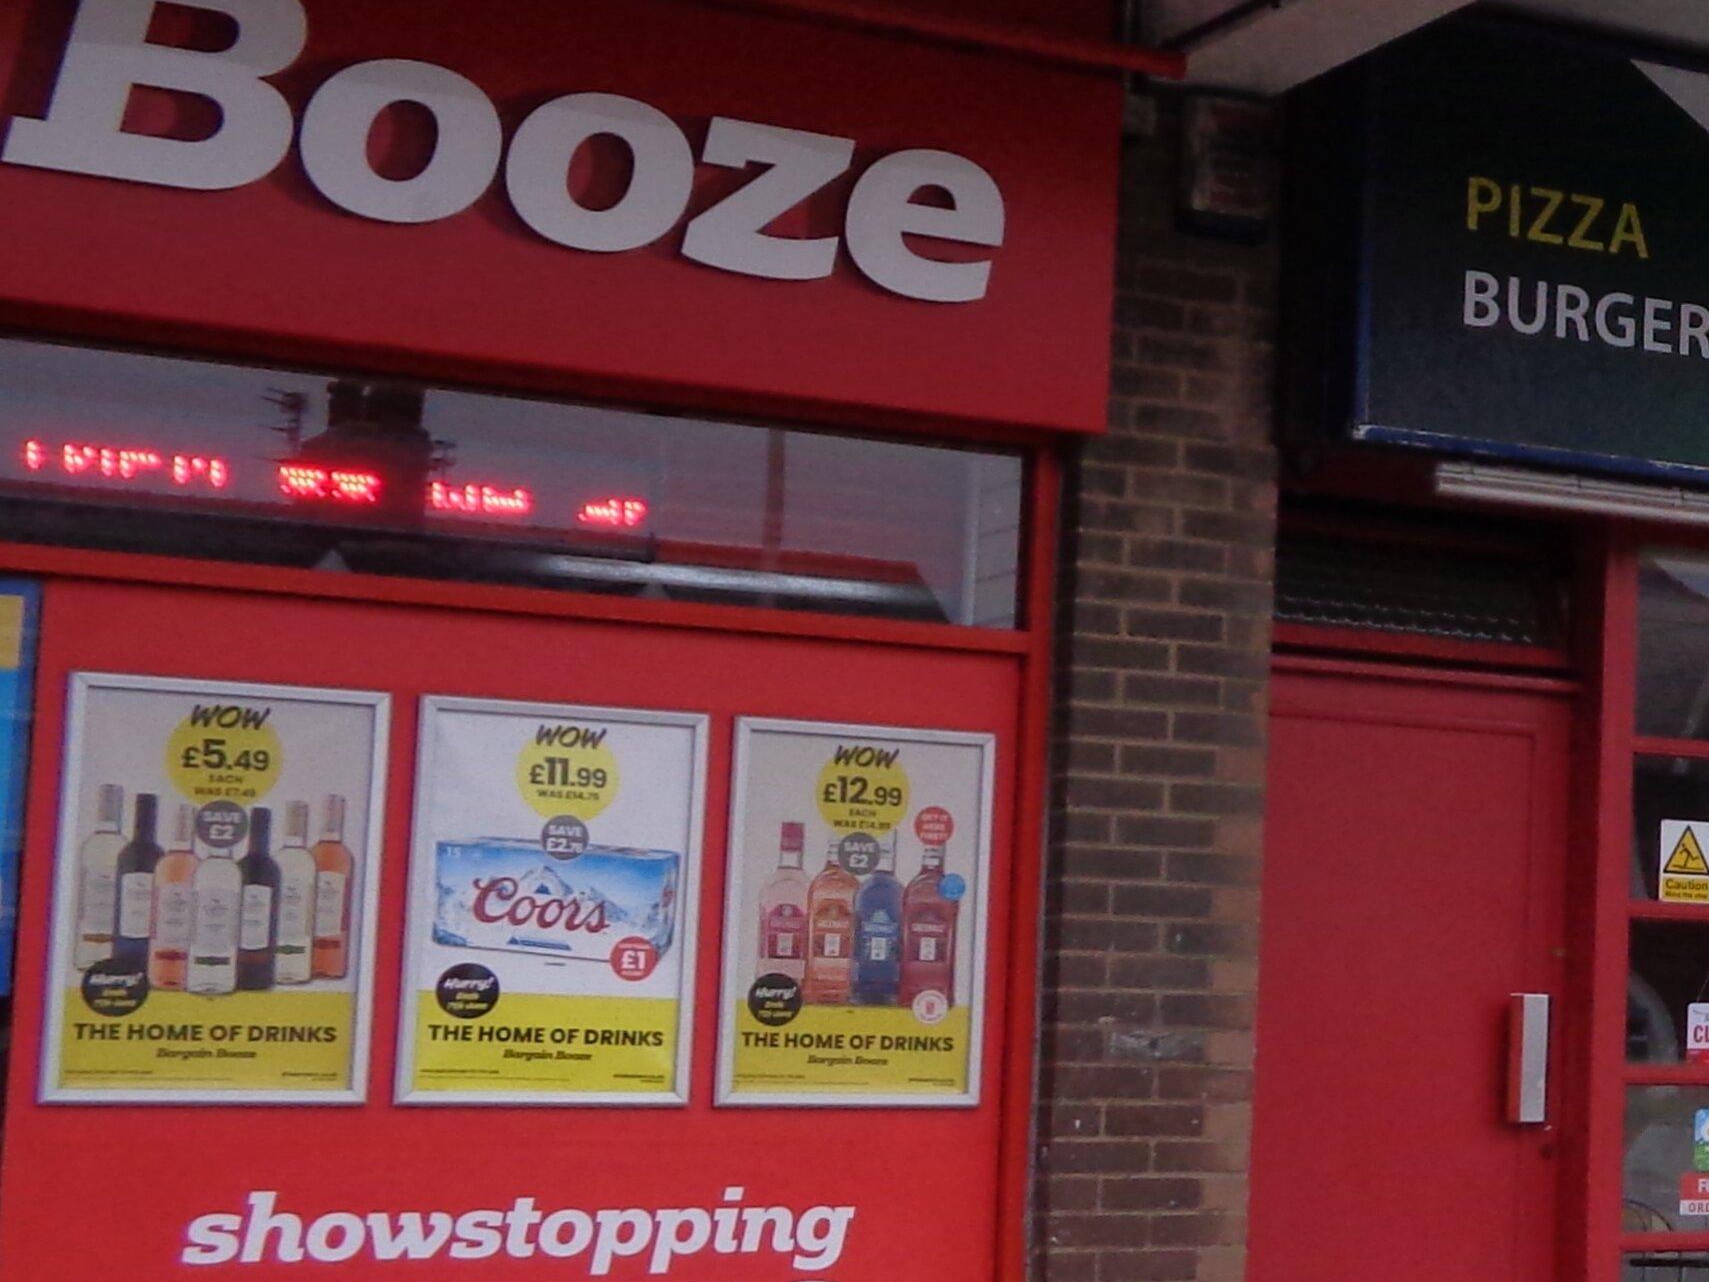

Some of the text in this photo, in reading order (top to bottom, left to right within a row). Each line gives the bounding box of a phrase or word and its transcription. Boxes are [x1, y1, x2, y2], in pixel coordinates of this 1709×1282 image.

[1467, 176, 1650, 259] PIZZA
[190, 704, 271, 730] WOW
[535, 724, 607, 749] WOW
[182, 738, 270, 771] £5.49
[834, 745, 899, 769] WOW
[530, 757, 606, 788] £11.99
[823, 776, 902, 806] £12.99
[209, 824, 234, 839] £2
[548, 825, 583, 836] SAVE
[1665, 878, 1709, 891] Caution
[473, 877, 610, 933] Coors
[621, 950, 646, 969] £1
[74, 1023, 337, 1043] THE HOME OF DRINKS
[428, 1024, 664, 1046] THE HOME OF DRINKS
[742, 1032, 955, 1052] THE HOME OF DRINKS
[180, 1187, 855, 1276] showstopping
